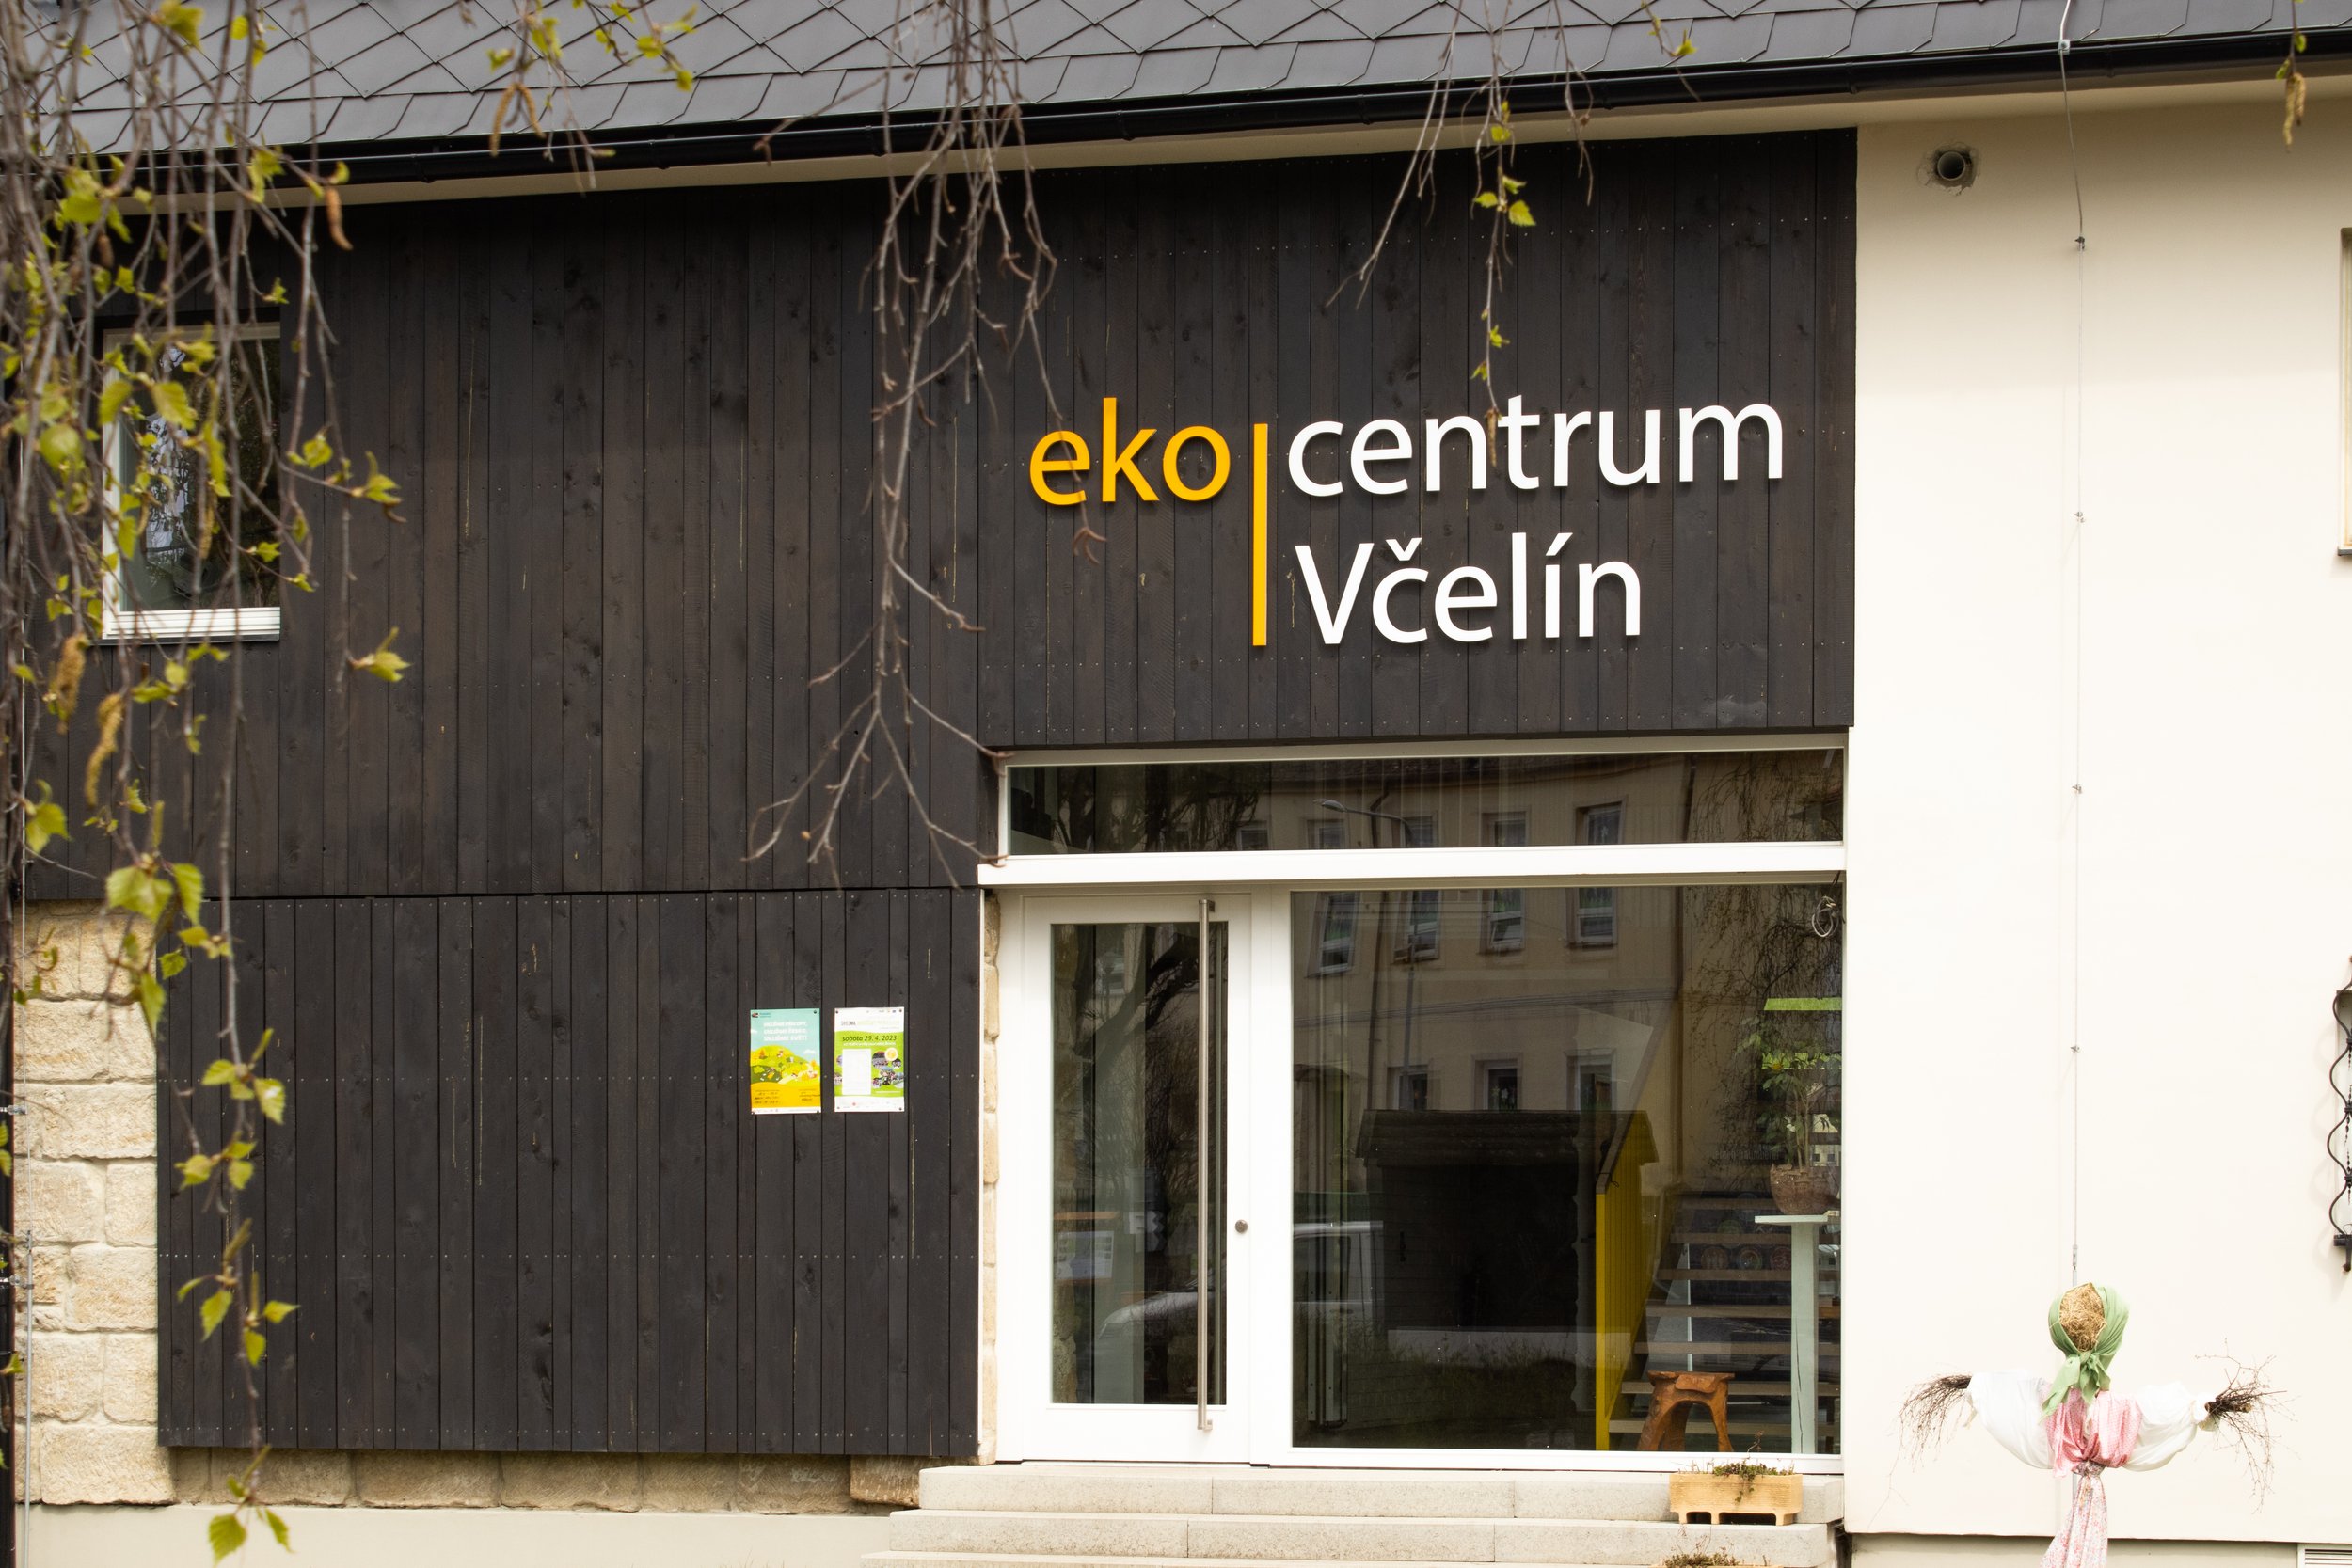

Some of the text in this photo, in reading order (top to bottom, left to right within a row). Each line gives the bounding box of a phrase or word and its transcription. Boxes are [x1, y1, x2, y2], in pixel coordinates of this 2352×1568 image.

[1030, 396, 1782, 504] eko centrum
[1295, 533, 1640, 643] Včelín
